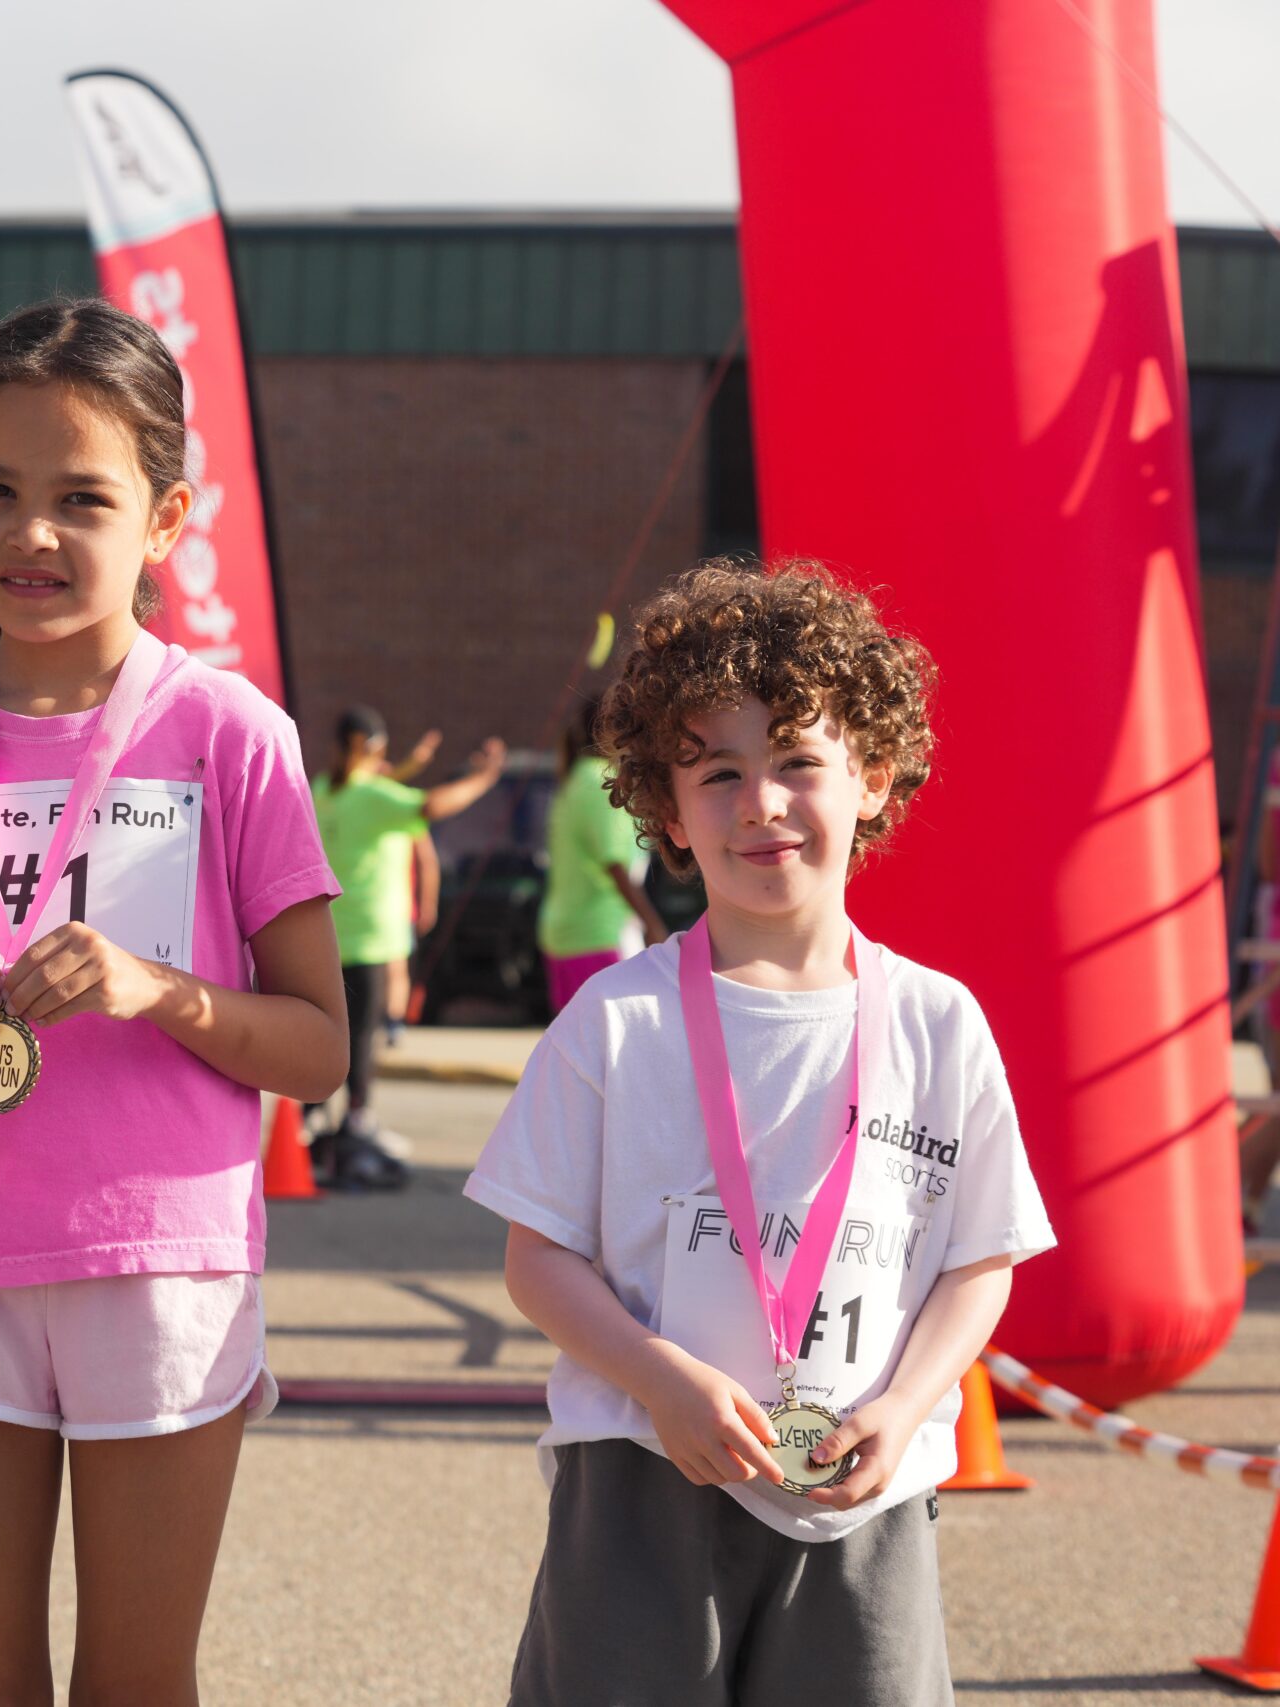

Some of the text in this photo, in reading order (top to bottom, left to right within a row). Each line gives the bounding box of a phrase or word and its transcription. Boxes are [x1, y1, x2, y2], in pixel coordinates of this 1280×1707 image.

[48, 803, 101, 825] Fn
[111, 803, 176, 831] Run!
[884, 1157, 950, 1196] sports
[836, 1219, 922, 1272] RUN
